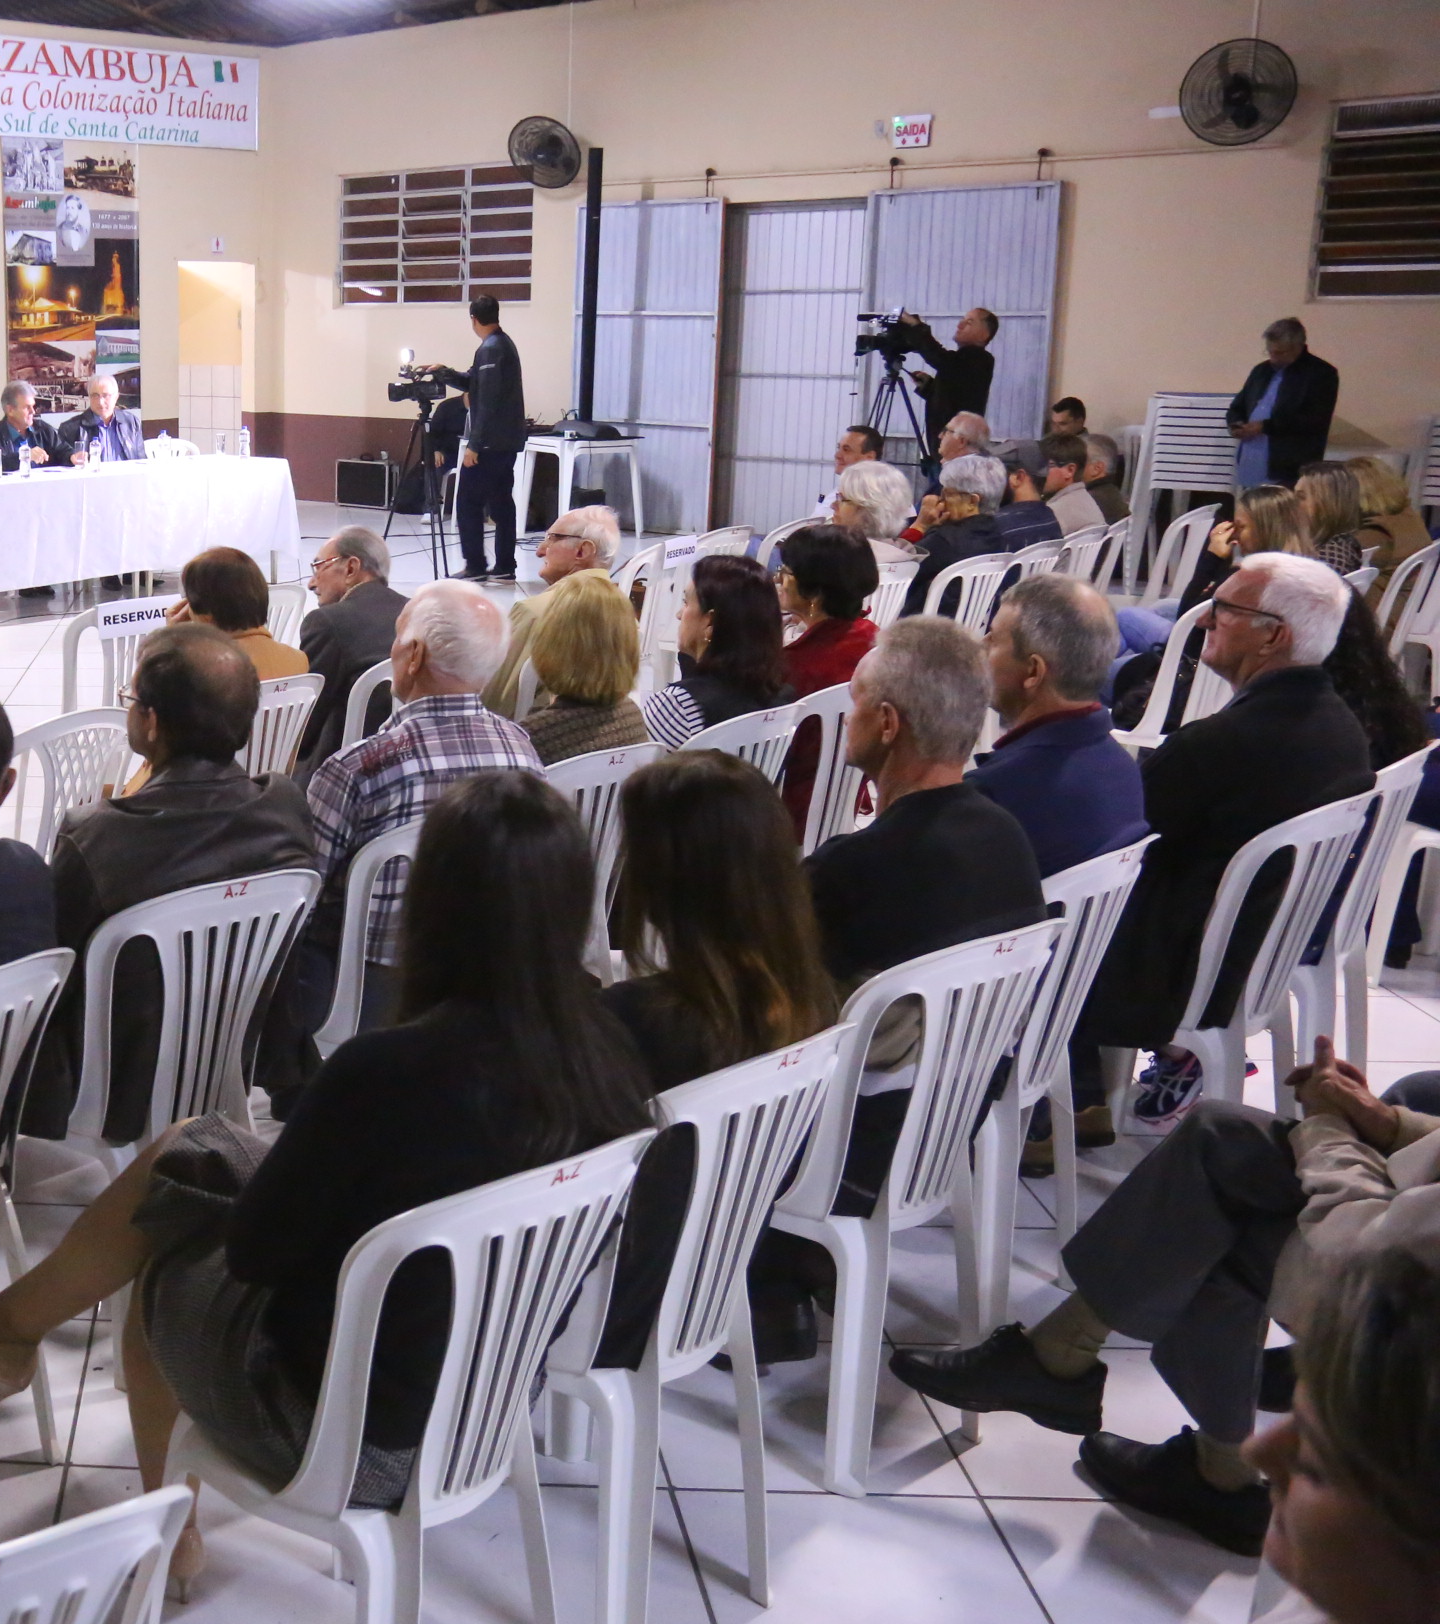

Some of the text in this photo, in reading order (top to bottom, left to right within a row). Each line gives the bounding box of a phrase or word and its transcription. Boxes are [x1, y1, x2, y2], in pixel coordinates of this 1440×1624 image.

[22, 78, 158, 121] Colonização
[166, 90, 248, 122] Italiana
[0, 111, 36, 133] Sul
[39, 113, 59, 134] de
[64, 117, 118, 138] Santa
[125, 121, 200, 143] Catarina
[666, 546, 695, 559] RESERVADO
[103, 608, 167, 626] RESERVAD
[224, 881, 249, 899] A.Z
